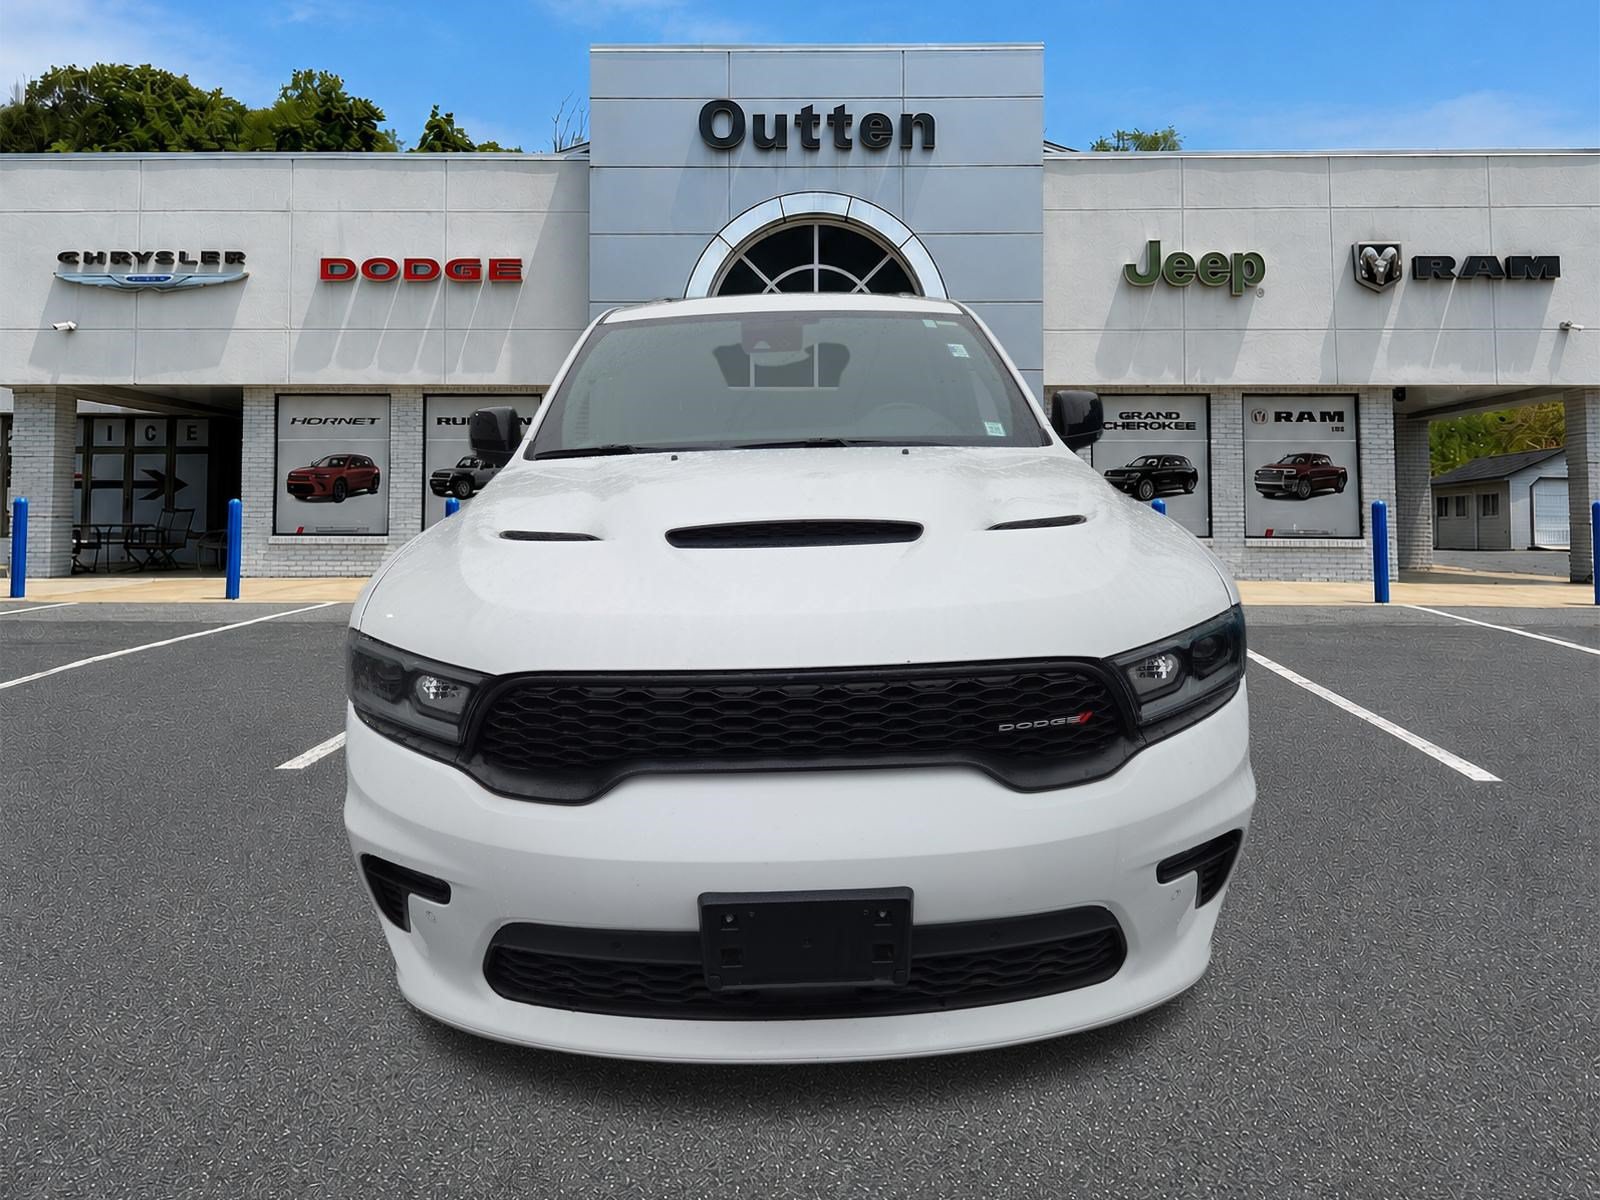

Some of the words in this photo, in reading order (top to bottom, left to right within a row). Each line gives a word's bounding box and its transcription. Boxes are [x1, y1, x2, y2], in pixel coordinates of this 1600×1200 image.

[699, 99, 936, 151] Outten
[57, 250, 247, 266] CHRYSLER
[320, 257, 523, 282] DODGE
[1123, 240, 1266, 297] Jeep
[1411, 255, 1561, 281] RAM
[290, 417, 381, 425] HORNET
[1119, 411, 1180, 420] GRAND
[1274, 411, 1344, 423] RAM
[1103, 421, 1197, 431] CHEROKEE
[998, 715, 1081, 732] DODGE
